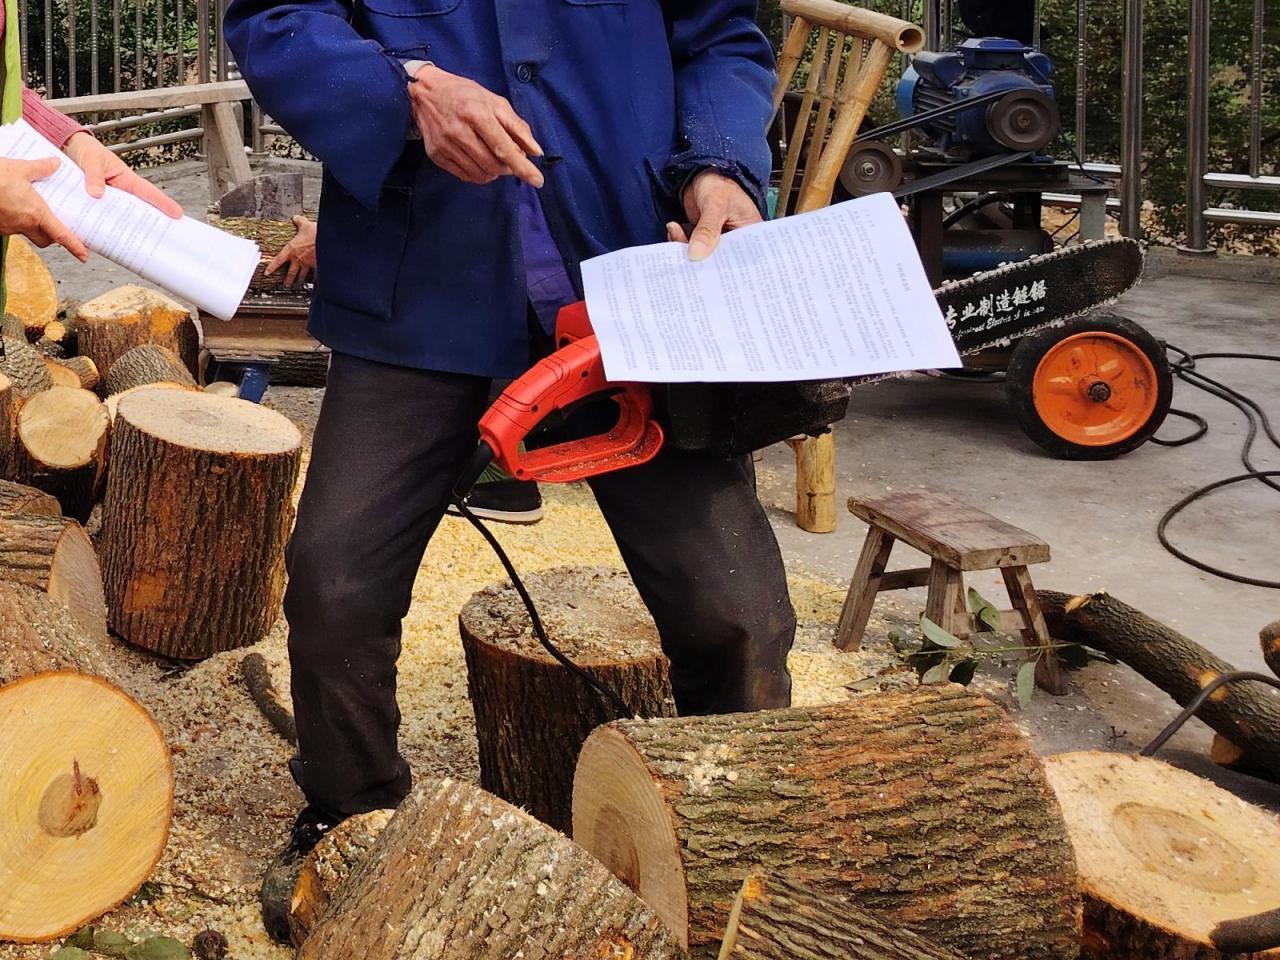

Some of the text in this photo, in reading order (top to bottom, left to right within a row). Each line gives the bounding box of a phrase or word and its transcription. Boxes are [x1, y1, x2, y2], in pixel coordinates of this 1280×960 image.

[945, 279, 1047, 330] 专业制造链锯
